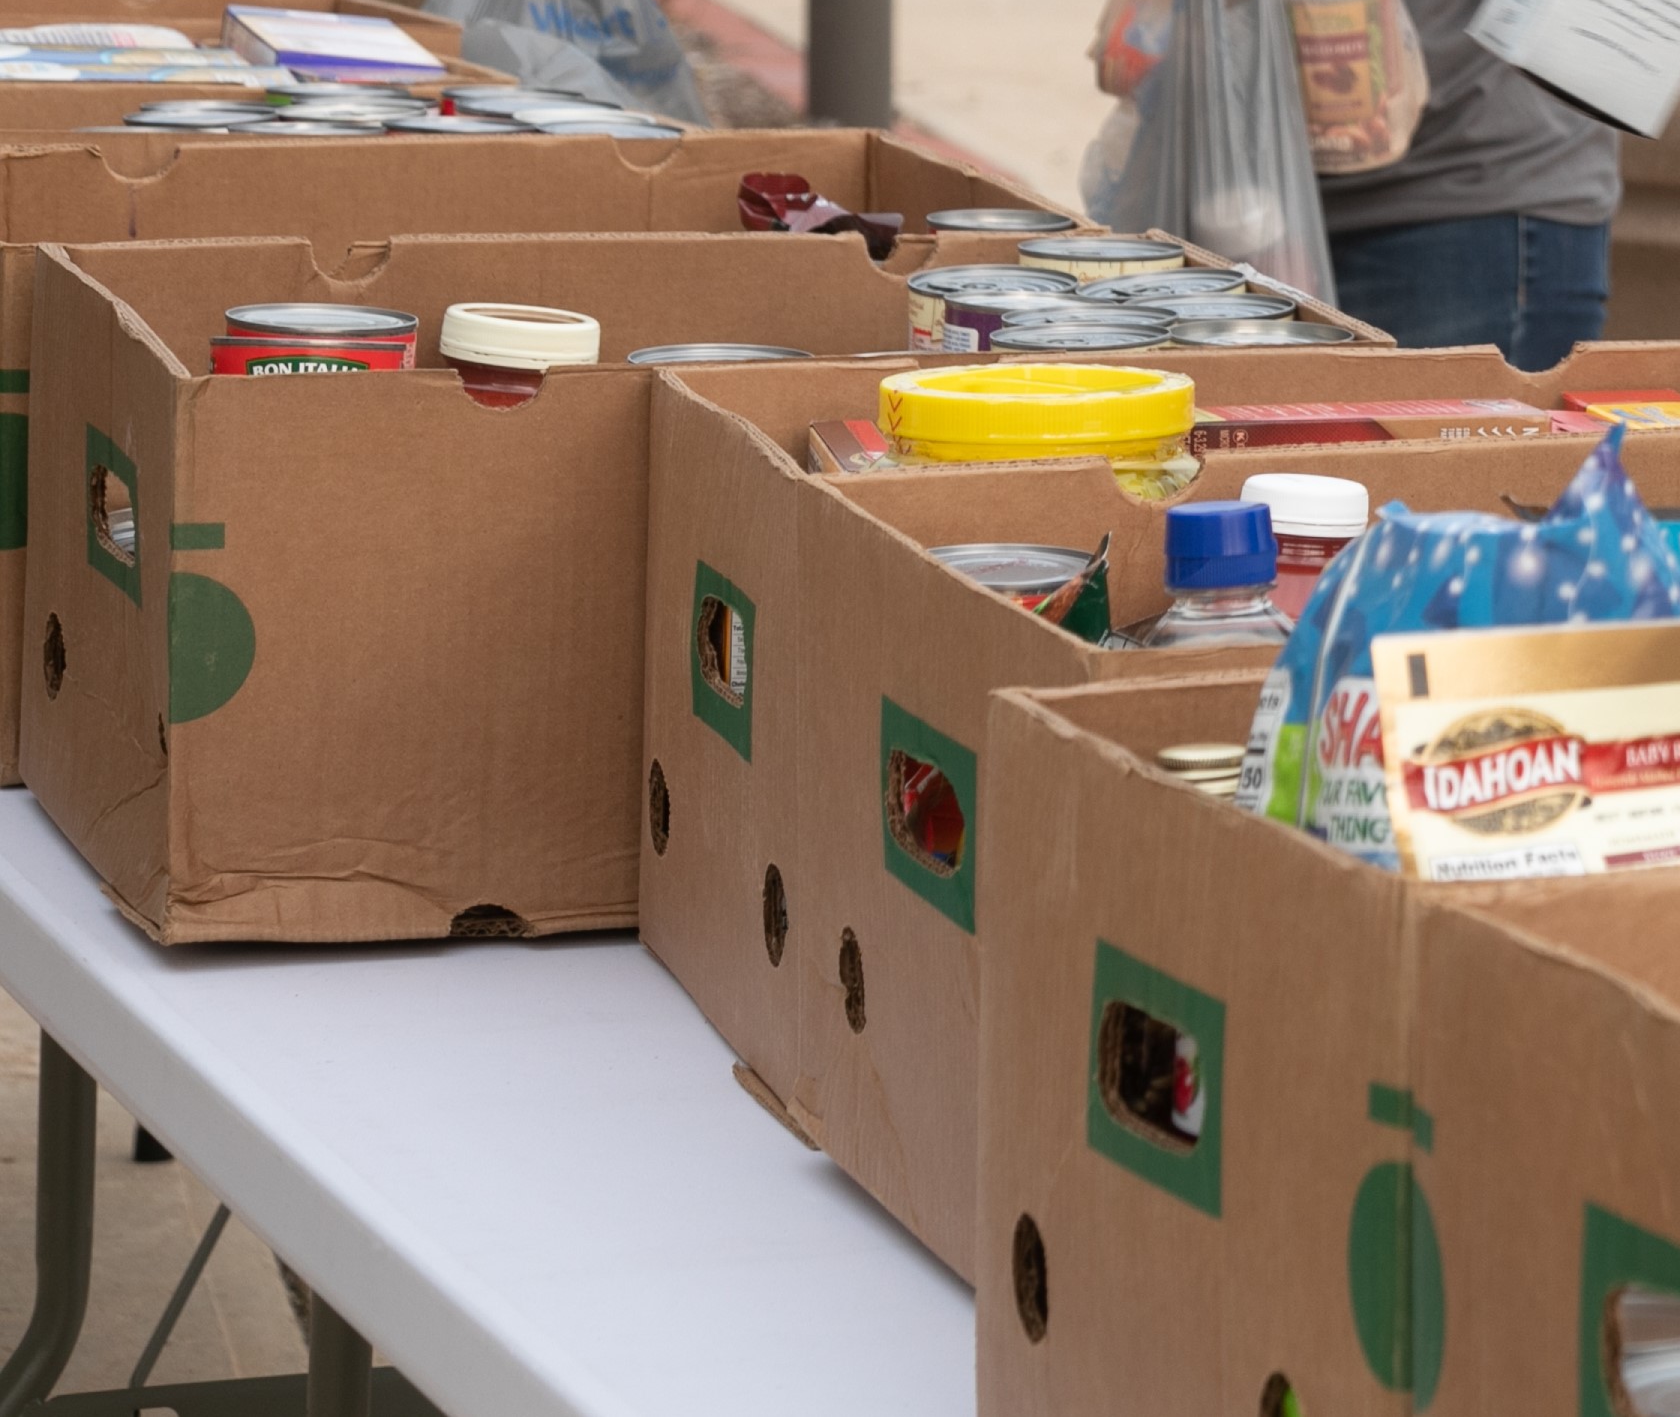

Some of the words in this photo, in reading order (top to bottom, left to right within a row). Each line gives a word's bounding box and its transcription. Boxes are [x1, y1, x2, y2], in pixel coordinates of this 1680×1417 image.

[252, 362, 293, 375] BON
[1625, 740, 1670, 769] BABY
[1423, 739, 1583, 811] IDAHOAN
[1435, 856, 1518, 880] Nutrition
[1525, 847, 1579, 869] Facts
